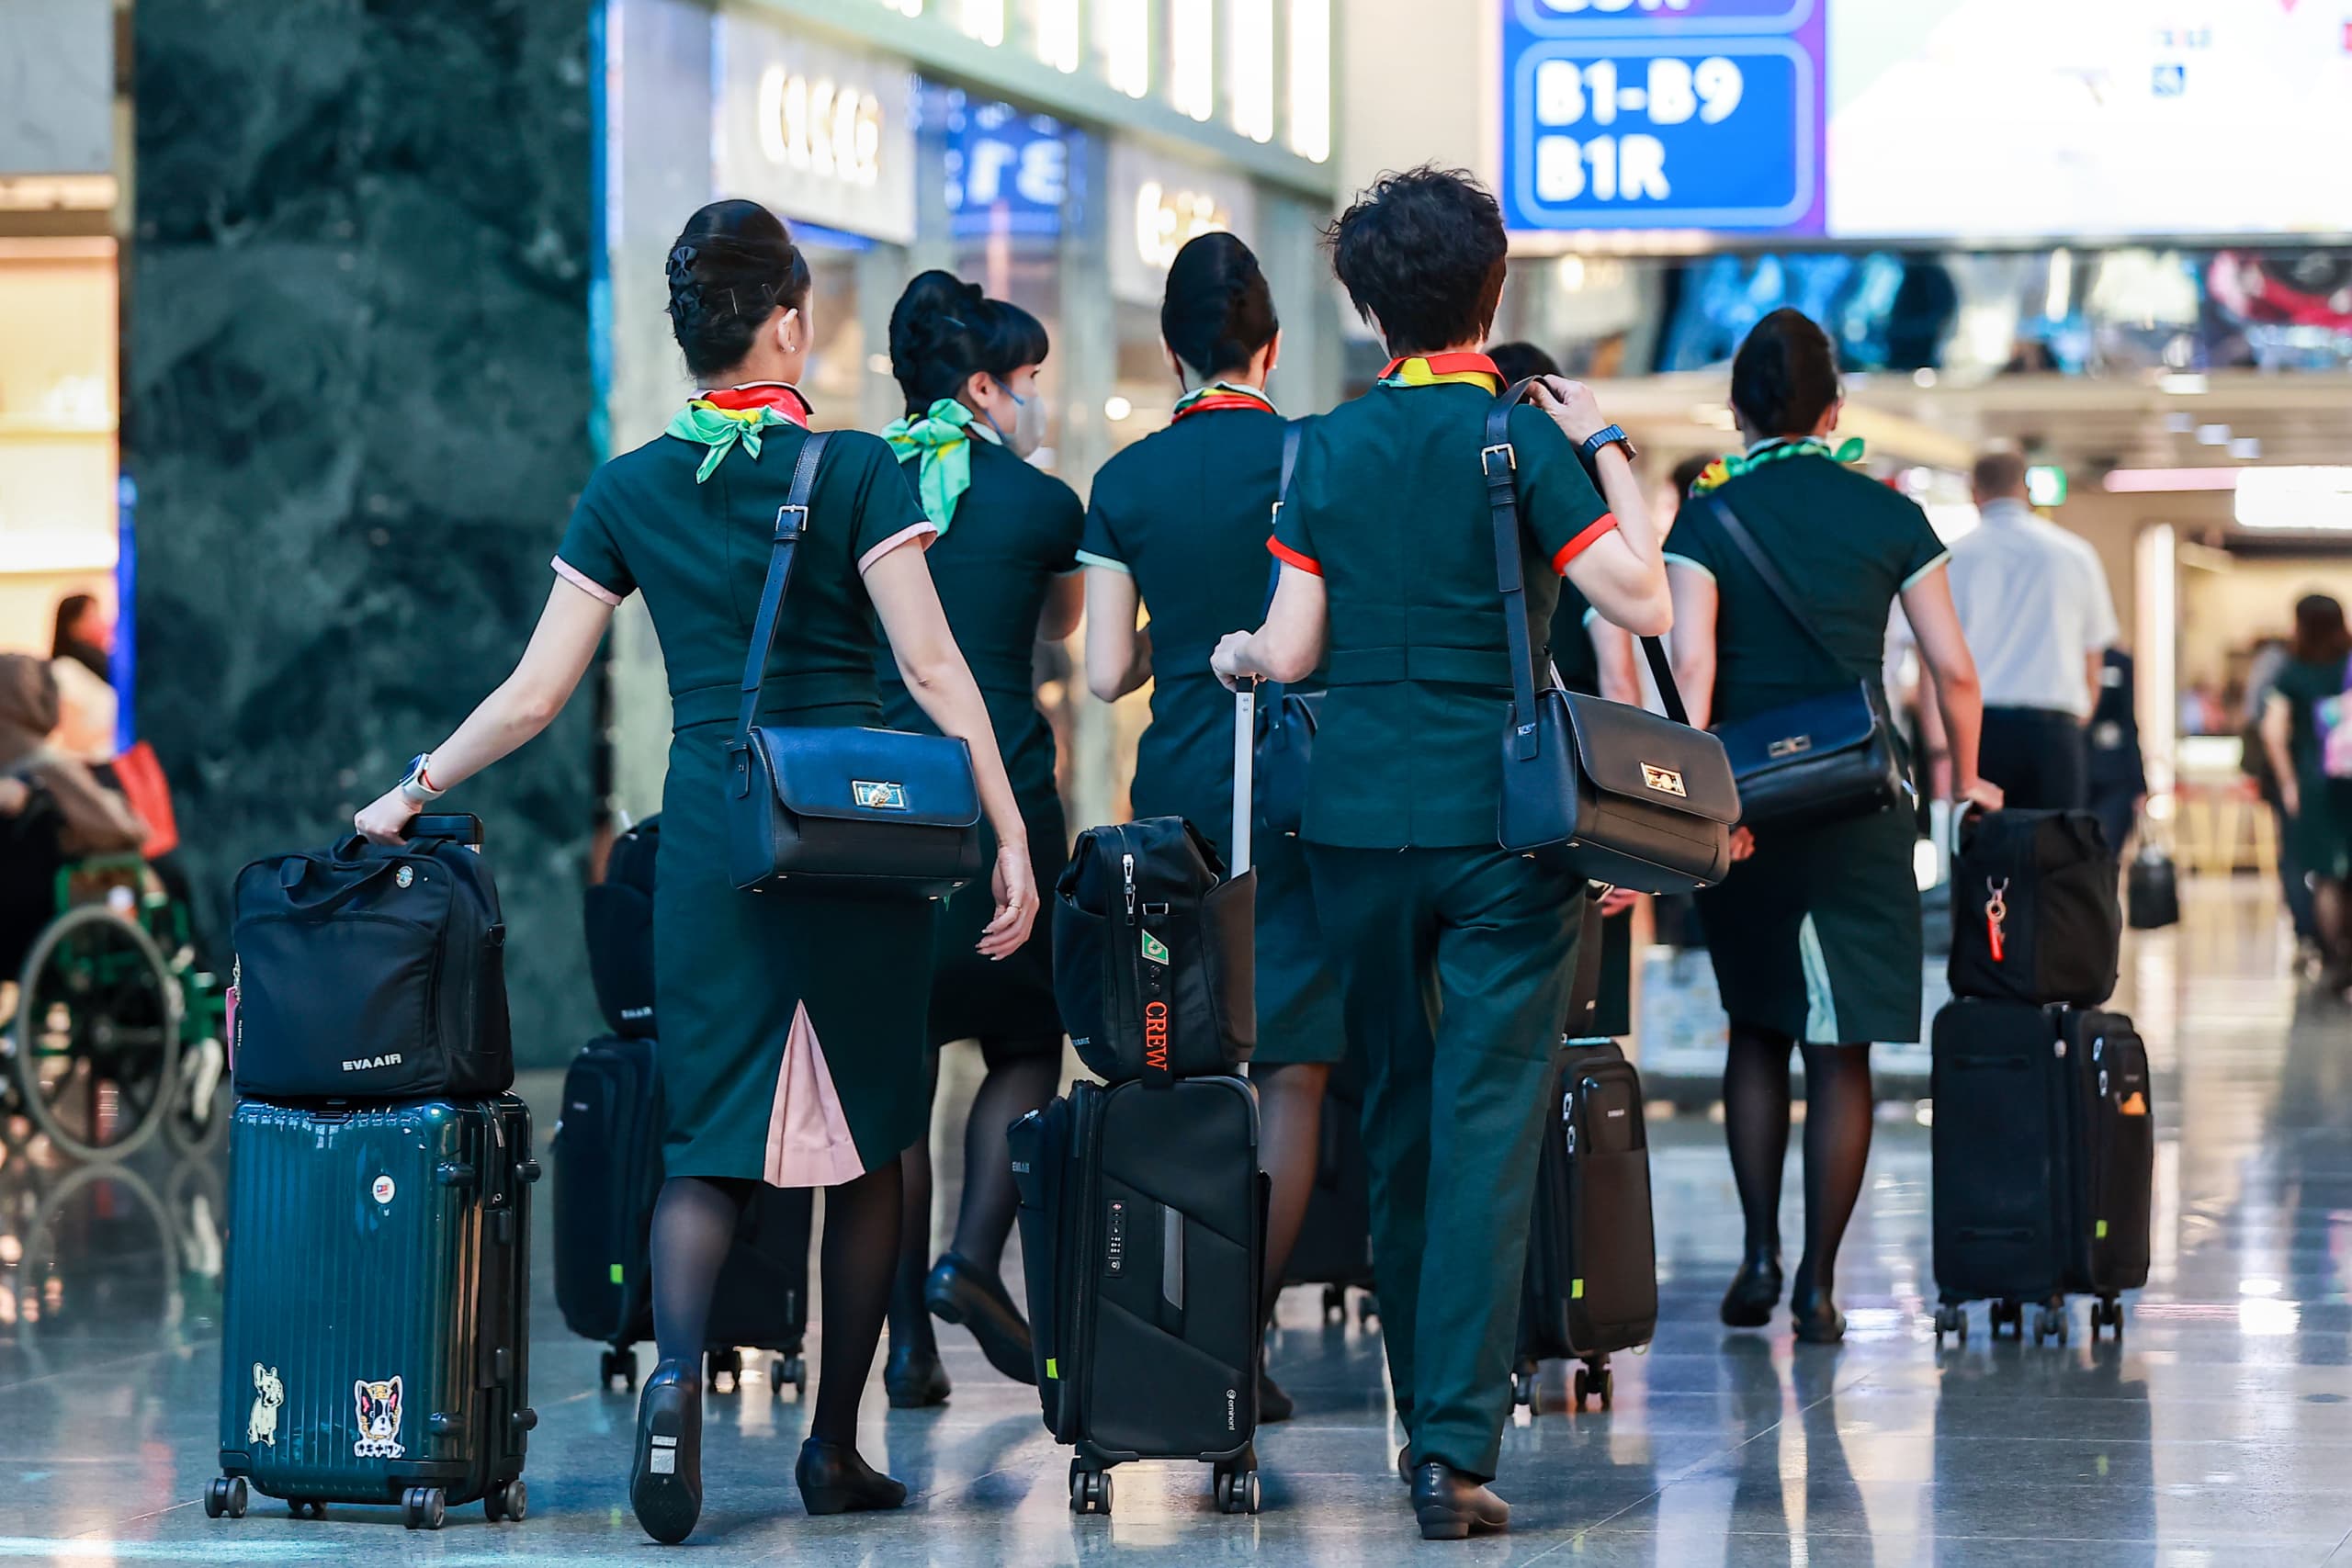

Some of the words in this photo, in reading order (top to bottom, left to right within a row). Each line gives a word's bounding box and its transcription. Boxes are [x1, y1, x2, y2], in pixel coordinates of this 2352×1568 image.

[1535, 55, 1744, 127] B1-B9
[1535, 132, 1671, 202] B1R
[1146, 1001, 1168, 1072] CREW
